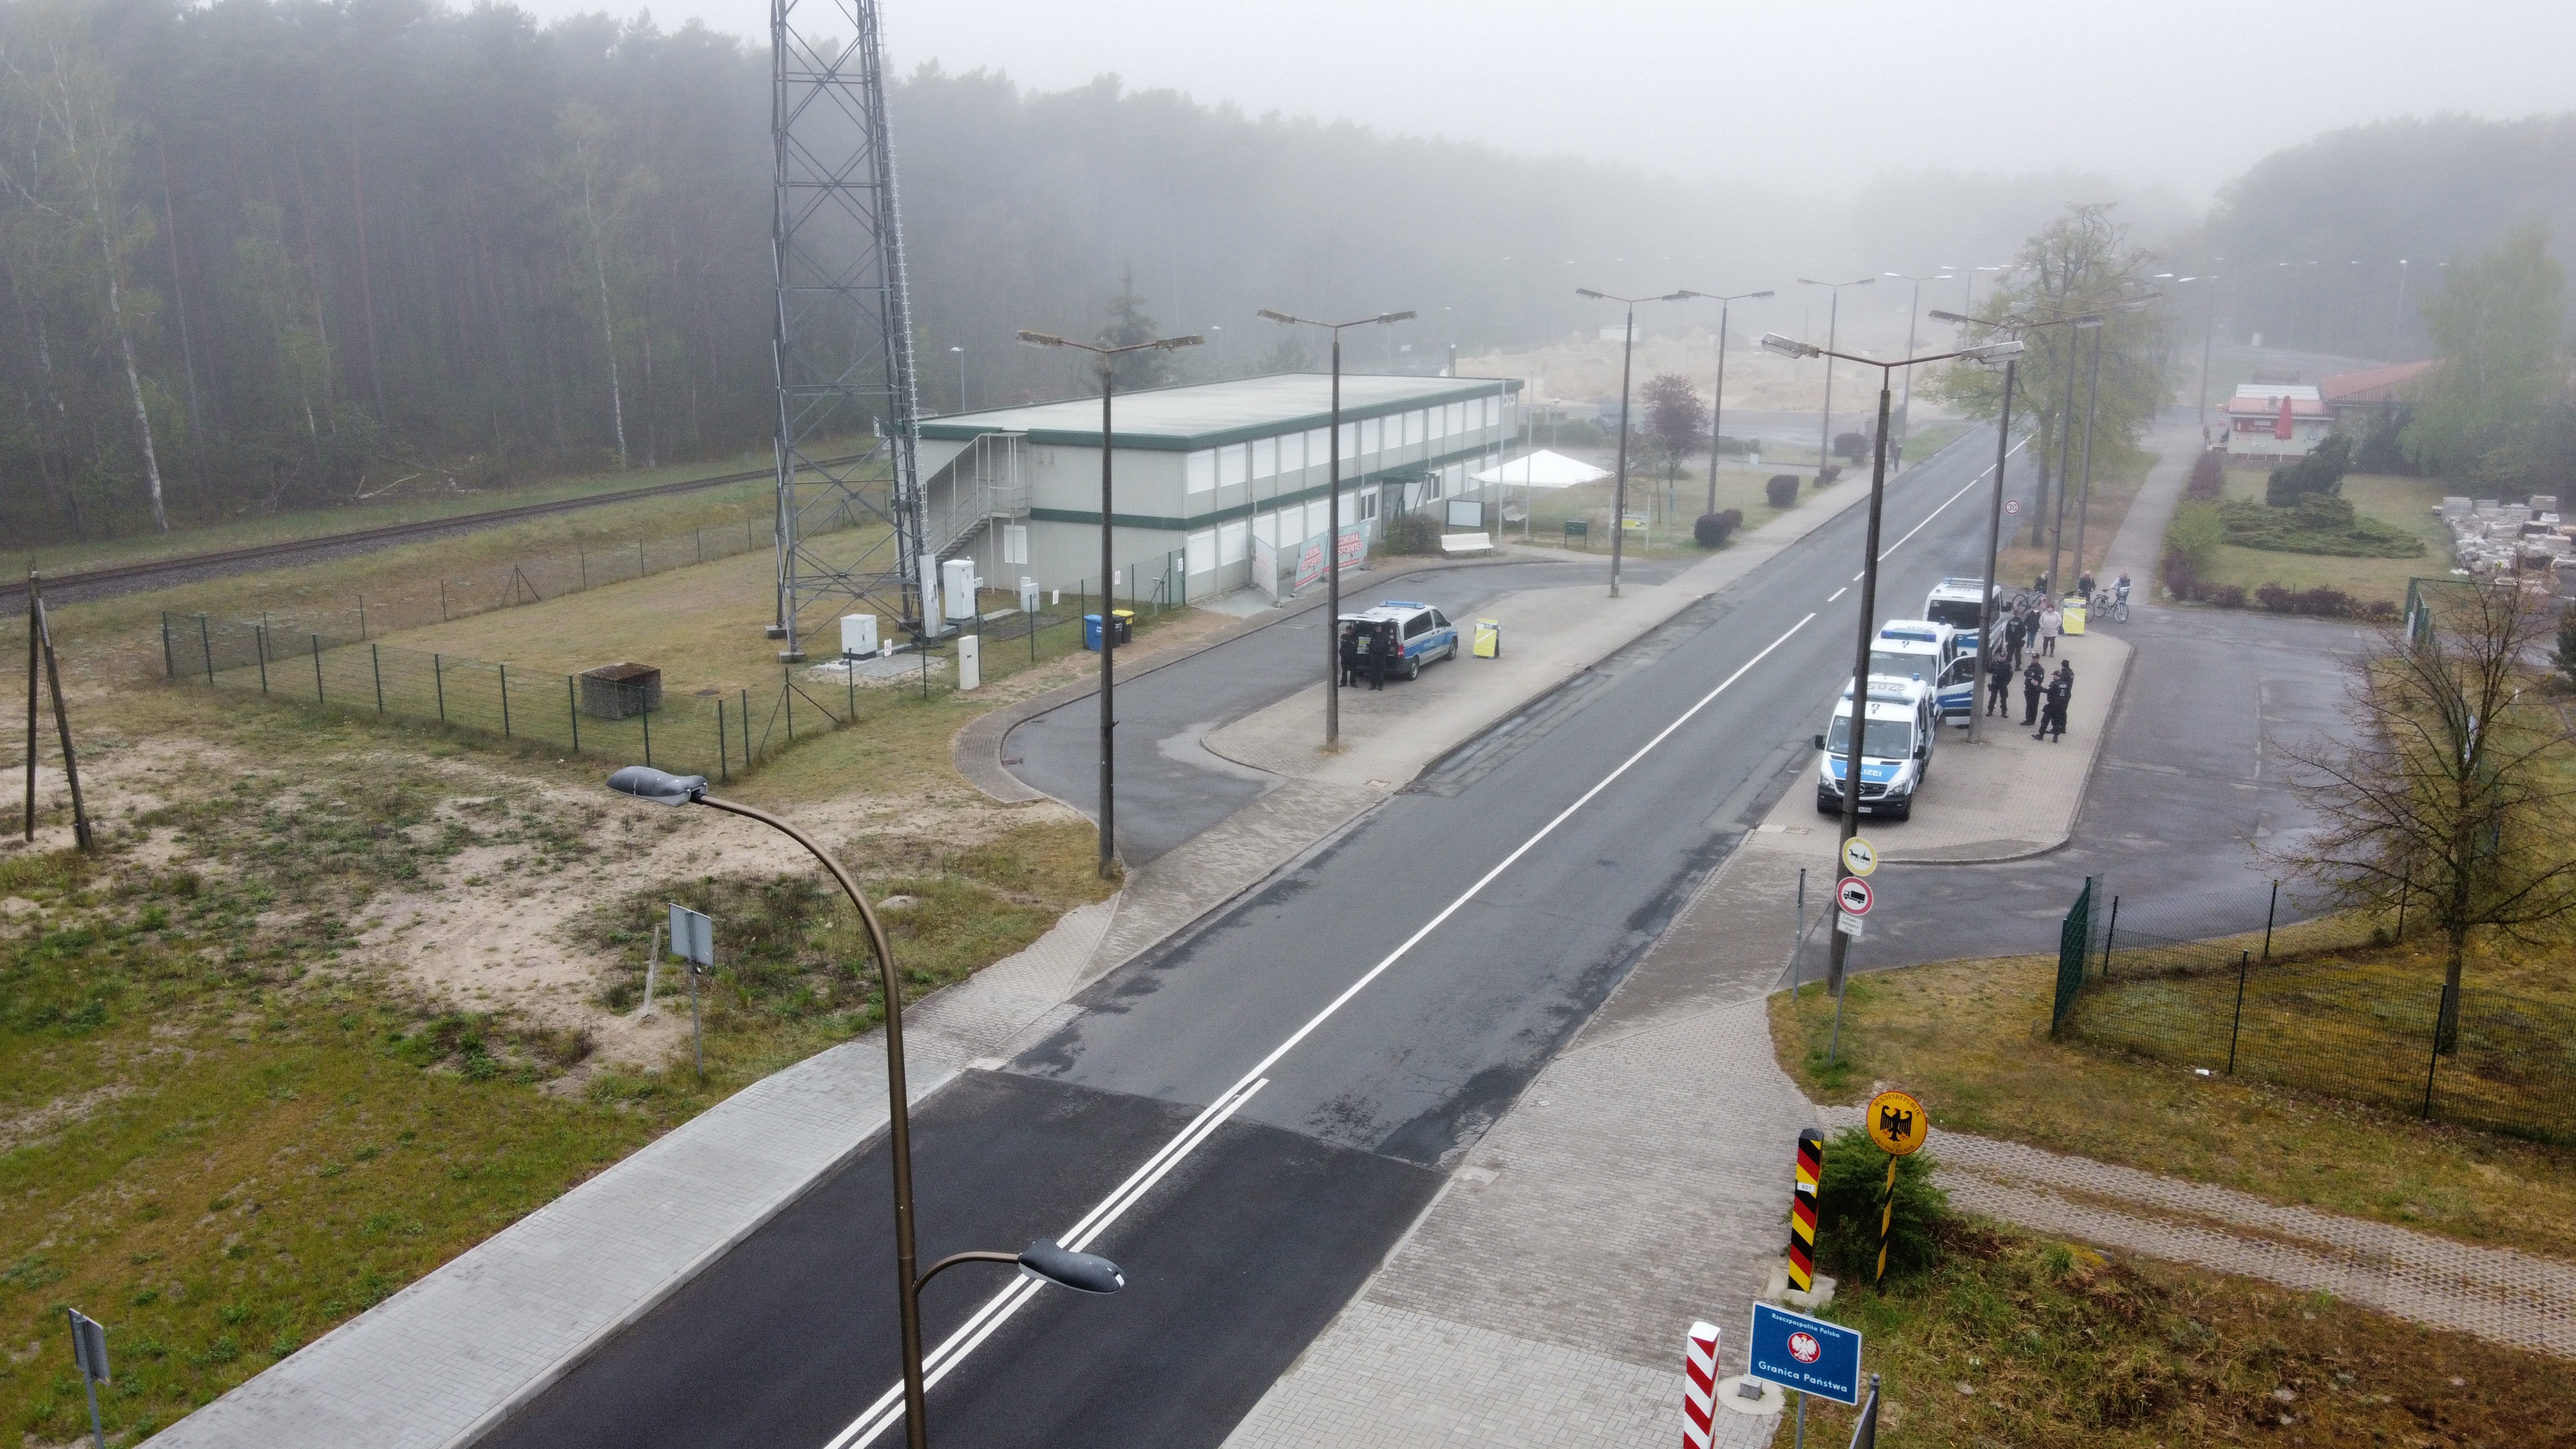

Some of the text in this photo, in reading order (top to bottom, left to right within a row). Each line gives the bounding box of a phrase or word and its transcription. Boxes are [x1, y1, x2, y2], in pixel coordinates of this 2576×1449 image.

[1873, 1094, 1921, 1117] BUNDESREPUBLIK
[1874, 1137, 1915, 1153] DEUTSCHLAND
[1772, 1312, 1840, 1338] Rzeczpospolita Polska
[1758, 1361, 1848, 1393] Granica Państwa
